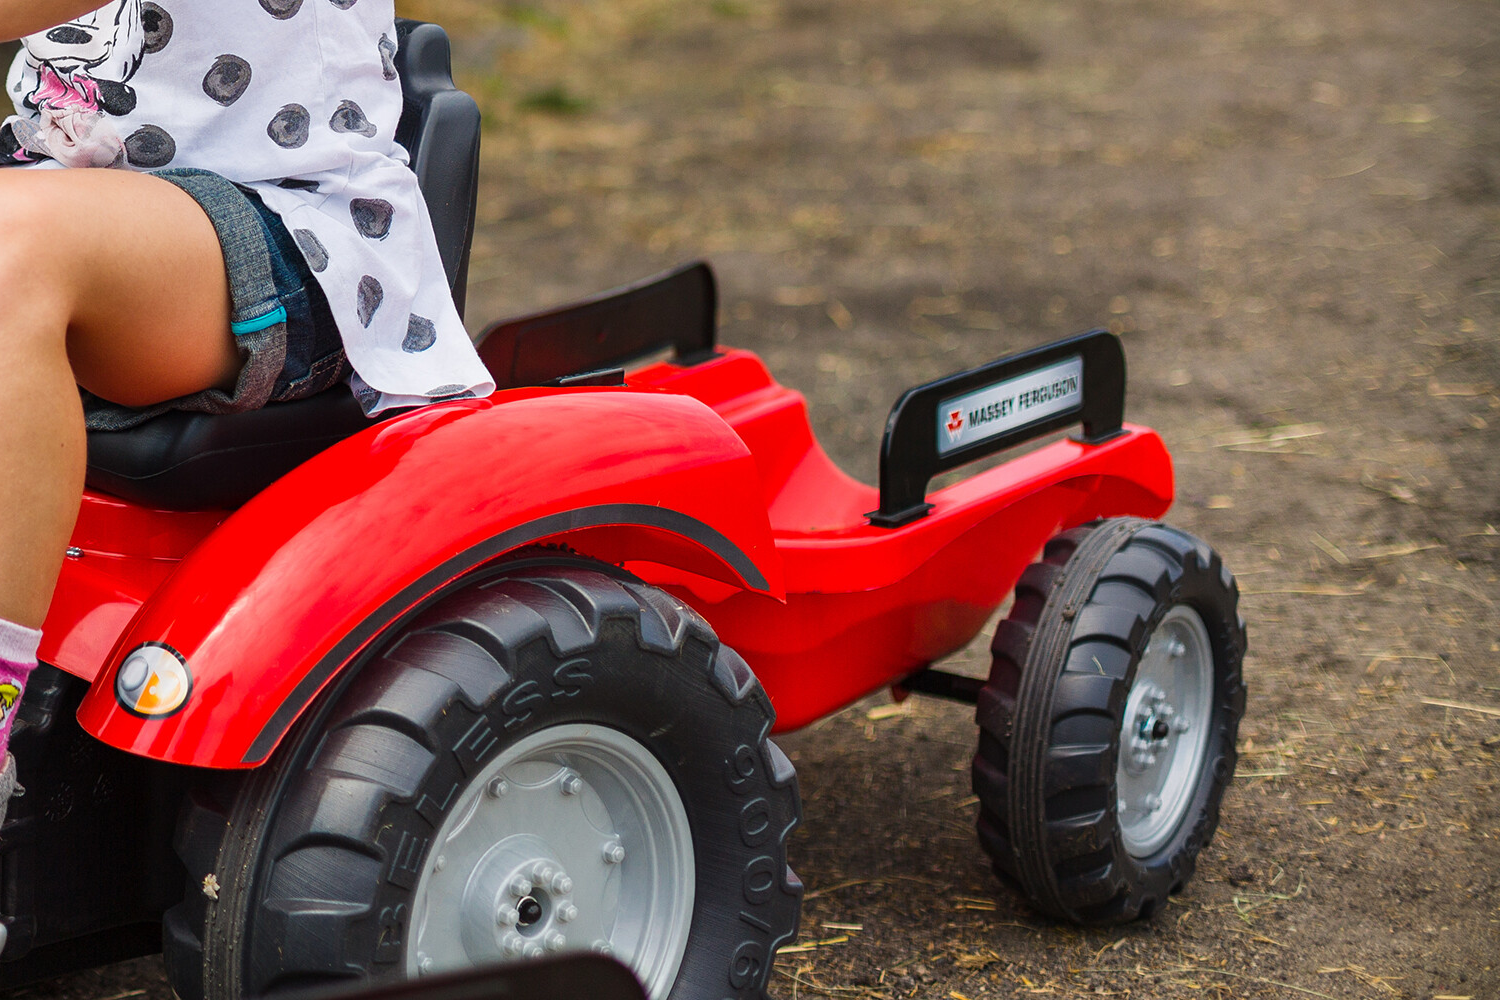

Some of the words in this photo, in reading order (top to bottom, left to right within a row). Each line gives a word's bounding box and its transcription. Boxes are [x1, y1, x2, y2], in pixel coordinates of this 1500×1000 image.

[968, 397, 1014, 429] MASSEY
[1018, 375, 1079, 411] FERGUSON
[371, 656, 595, 964] BELESS
[724, 743, 775, 1000] 900/6
